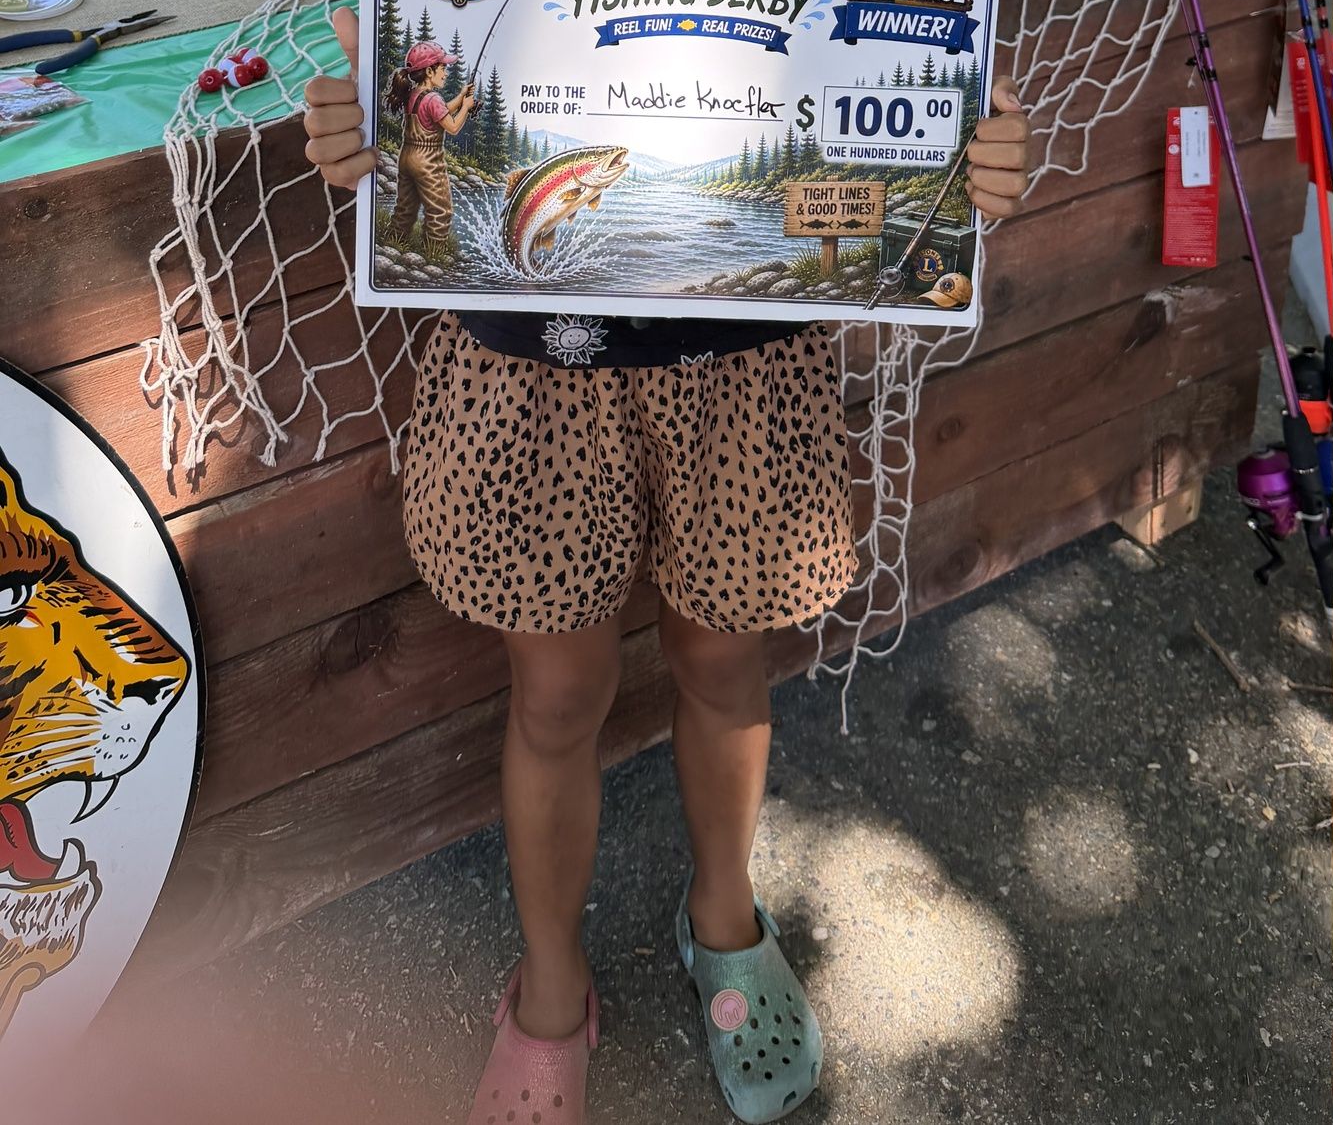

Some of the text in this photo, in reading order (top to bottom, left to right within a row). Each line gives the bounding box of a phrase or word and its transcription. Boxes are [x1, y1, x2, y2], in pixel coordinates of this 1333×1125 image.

[613, 18, 776, 42] REEL FUN! REAL PRIZES!
[857, 9, 956, 40] WINNER!
[521, 85, 586, 99] PAY TO THE
[607, 81, 687, 111] Maddie
[520, 101, 582, 115] ORDER OF:
[795, 94, 816, 132] $
[826, 145, 946, 162] ONE HUNDRED DOLLARS
[803, 187, 871, 201] TIGHT LINES
[796, 202, 876, 215] & GOOD TIMES!
